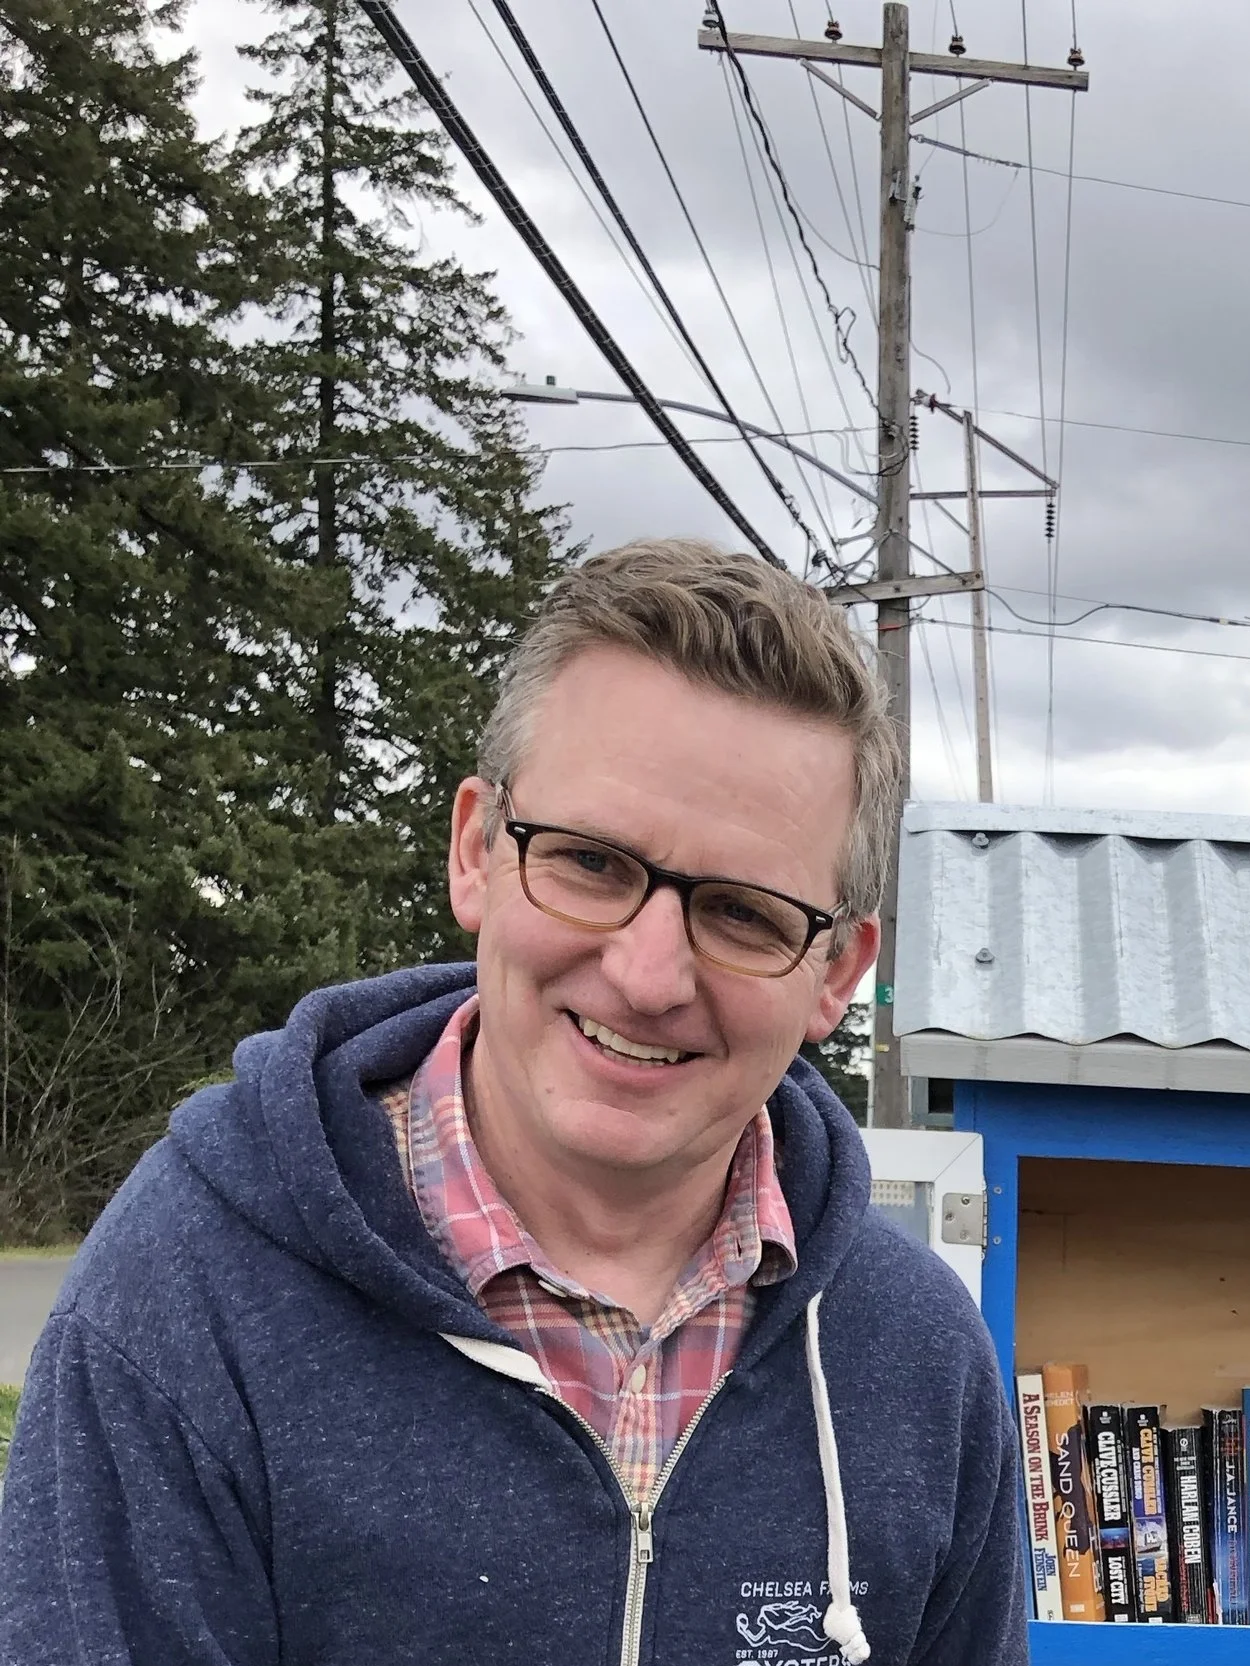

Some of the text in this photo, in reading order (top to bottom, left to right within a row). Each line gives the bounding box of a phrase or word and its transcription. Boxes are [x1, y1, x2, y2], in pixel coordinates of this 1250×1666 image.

[1097, 1432, 1117, 1468] CLIVE
[1132, 1447, 1140, 1460] AND
[1140, 1429, 1154, 1463] CLIVE
[1022, 1394, 1049, 1541] A SEASON ON THE BRINK
[1133, 1461, 1141, 1480] CRAIG
[1226, 1461, 1235, 1485] J.A.
[1055, 1433, 1080, 1578] SAND QUEEN
[1101, 1468, 1122, 1521] CUSSLER
[1143, 1465, 1157, 1515] CUSSLER
[1180, 1476, 1199, 1521] HARLAN
[1226, 1488, 1237, 1533] JANCE
[1182, 1525, 1201, 1564] COBEN
[1034, 1548, 1047, 1591] FEINSTEIN
[1045, 1554, 1056, 1576] JOHN
[1108, 1556, 1125, 1580] LOST
[740, 1580, 869, 1597] CHELSEA FMS
[1111, 1582, 1125, 1604] CITY
[736, 1650, 778, 1658] EST. 1987
